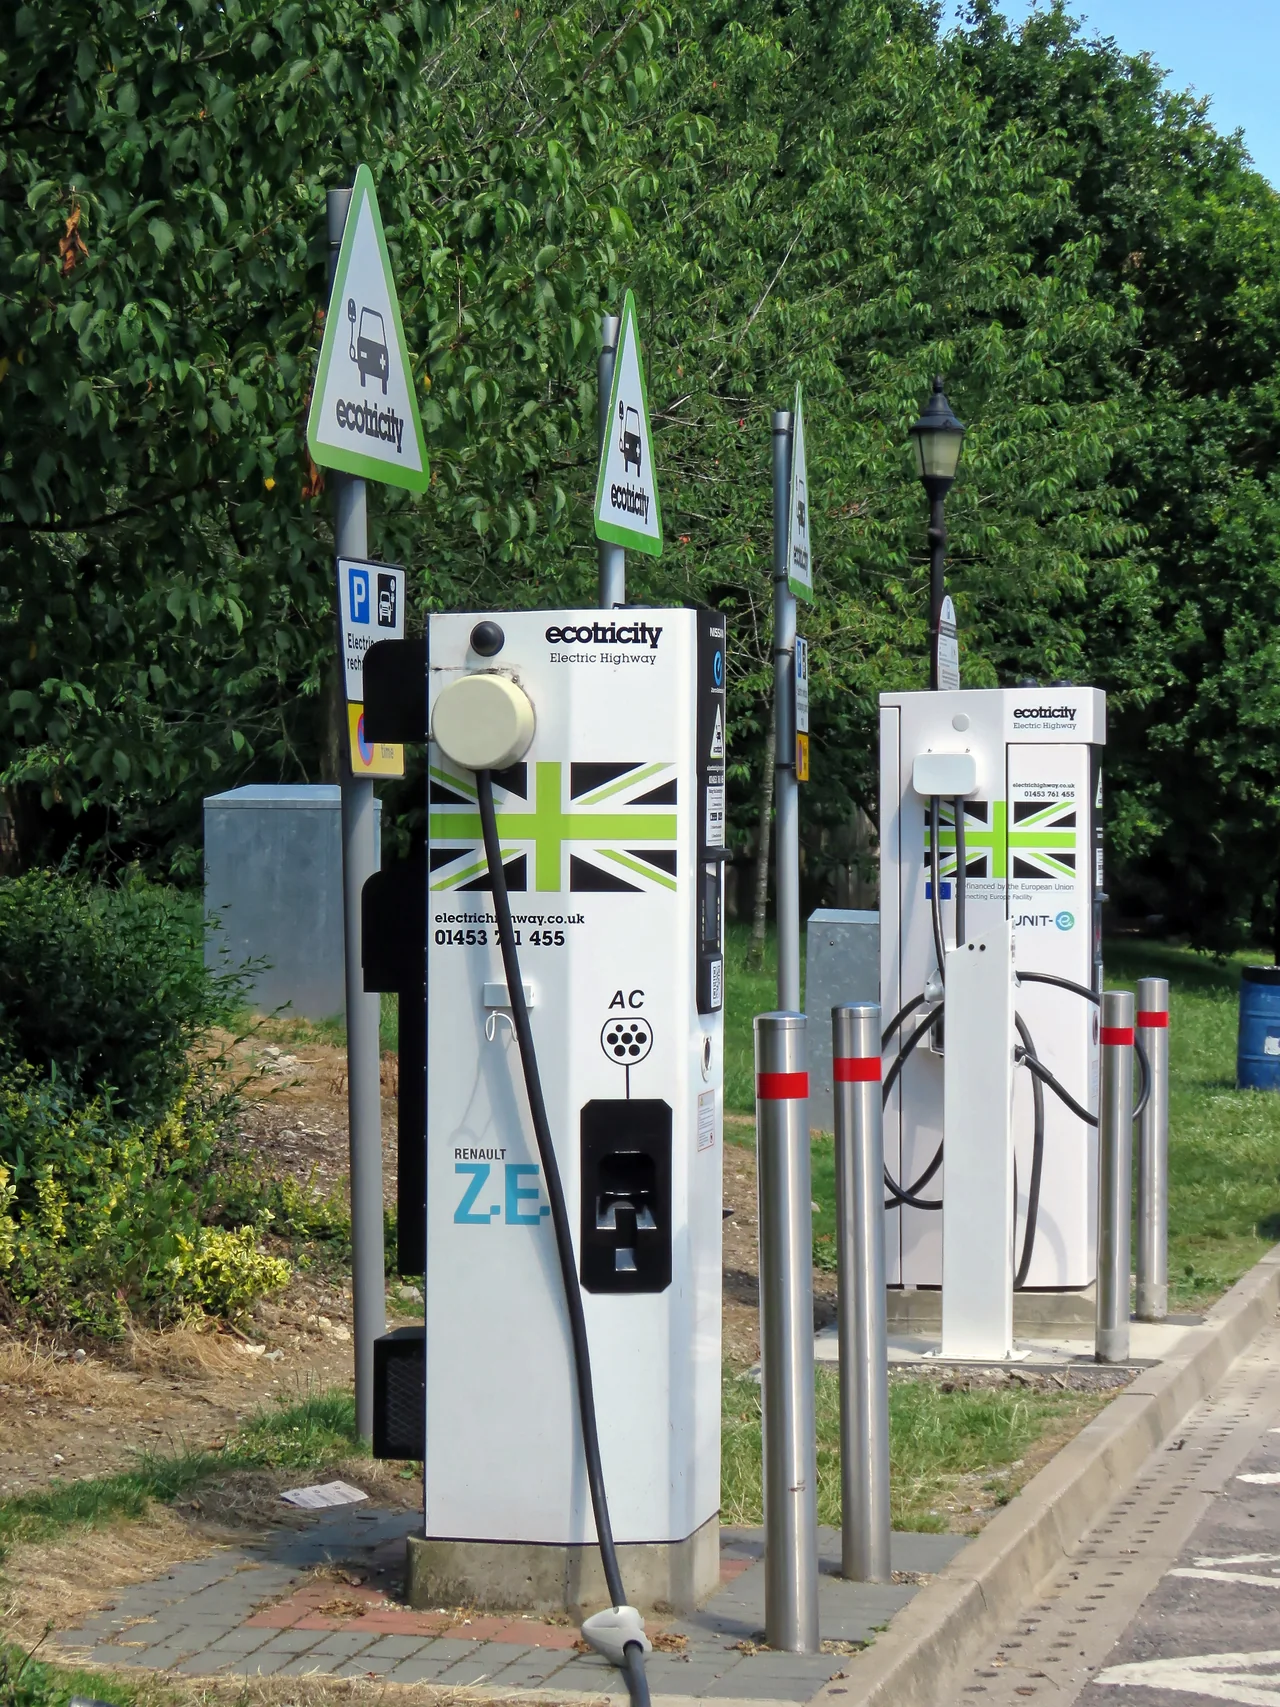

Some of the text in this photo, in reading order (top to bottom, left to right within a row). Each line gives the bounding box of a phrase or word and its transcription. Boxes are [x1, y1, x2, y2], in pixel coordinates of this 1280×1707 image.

[336, 398, 404, 453] ecotricity
[610, 482, 649, 525] ecotricity
[353, 575, 366, 618] P
[545, 621, 663, 649] ecotricity
[549, 652, 657, 666] Electric Highway
[1013, 706, 1077, 721] ecotricity
[1013, 722, 1077, 731] Electric Highway
[1020, 882, 1053, 892] European
[1054, 883, 1075, 891] Union
[1012, 893, 1033, 902] Facility
[434, 929, 566, 947] 01453 71 455
[608, 989, 645, 1010] AC
[454, 1148, 507, 1161] RENAULT
